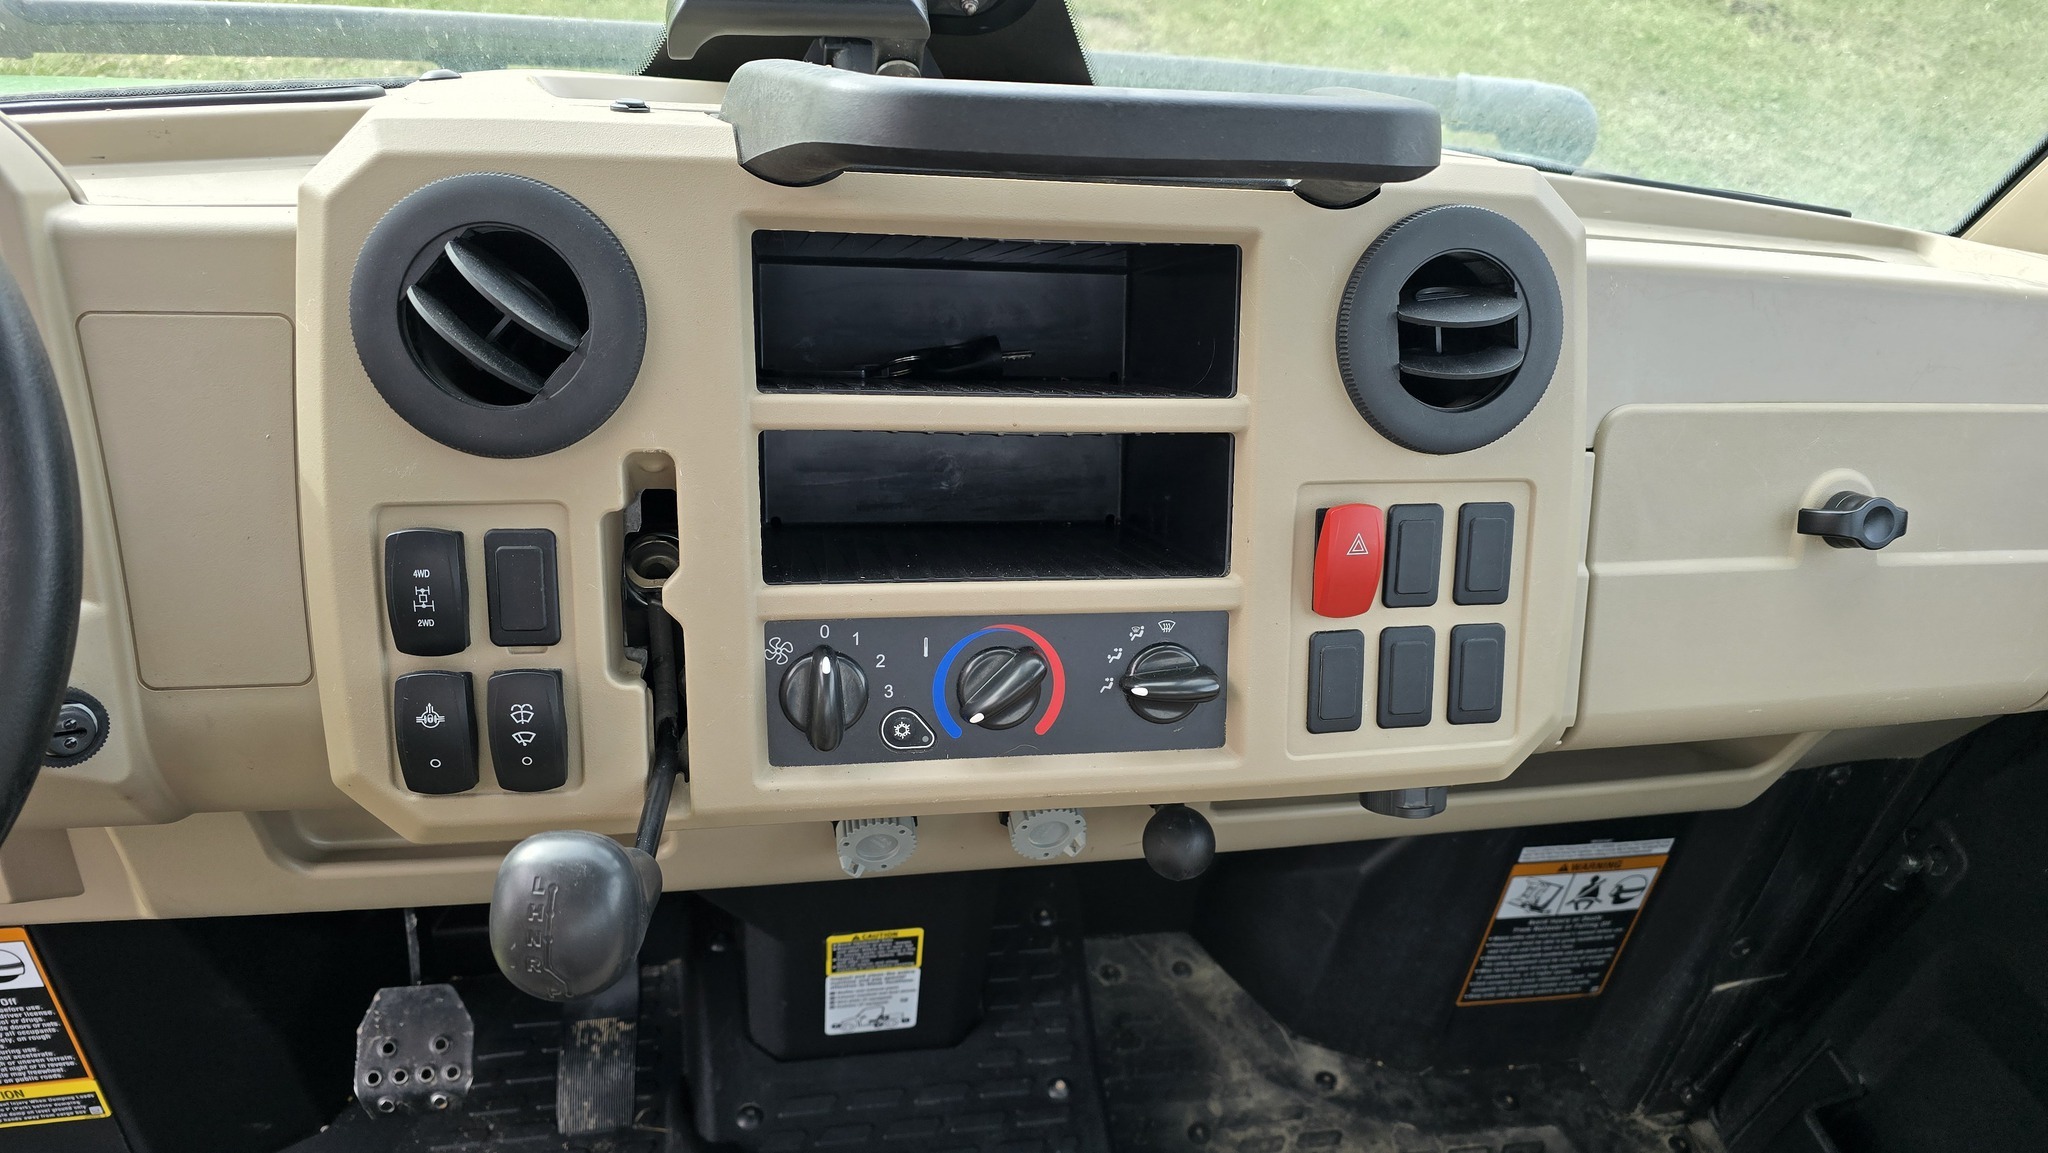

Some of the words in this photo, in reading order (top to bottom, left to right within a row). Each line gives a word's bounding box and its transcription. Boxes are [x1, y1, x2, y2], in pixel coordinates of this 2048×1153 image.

[413, 569, 430, 578] 4WD
[417, 619, 435, 627] 2WD
[820, 624, 830, 638] 0
[852, 632, 859, 646] 1
[876, 654, 886, 668] 2
[884, 684, 894, 698] 3
[1571, 860, 1624, 871] WARNING
[532, 876, 545, 896] L
[527, 903, 545, 922] H
[527, 929, 542, 948] N
[862, 932, 898, 940] CAUTION
[527, 957, 542, 973] R
[0, 998, 17, 1006] Off
[16, 1028, 59, 1036] occupants.
[12, 1051, 56, 1060] accelerate.
[27, 1068, 66, 1076] freewheel.
